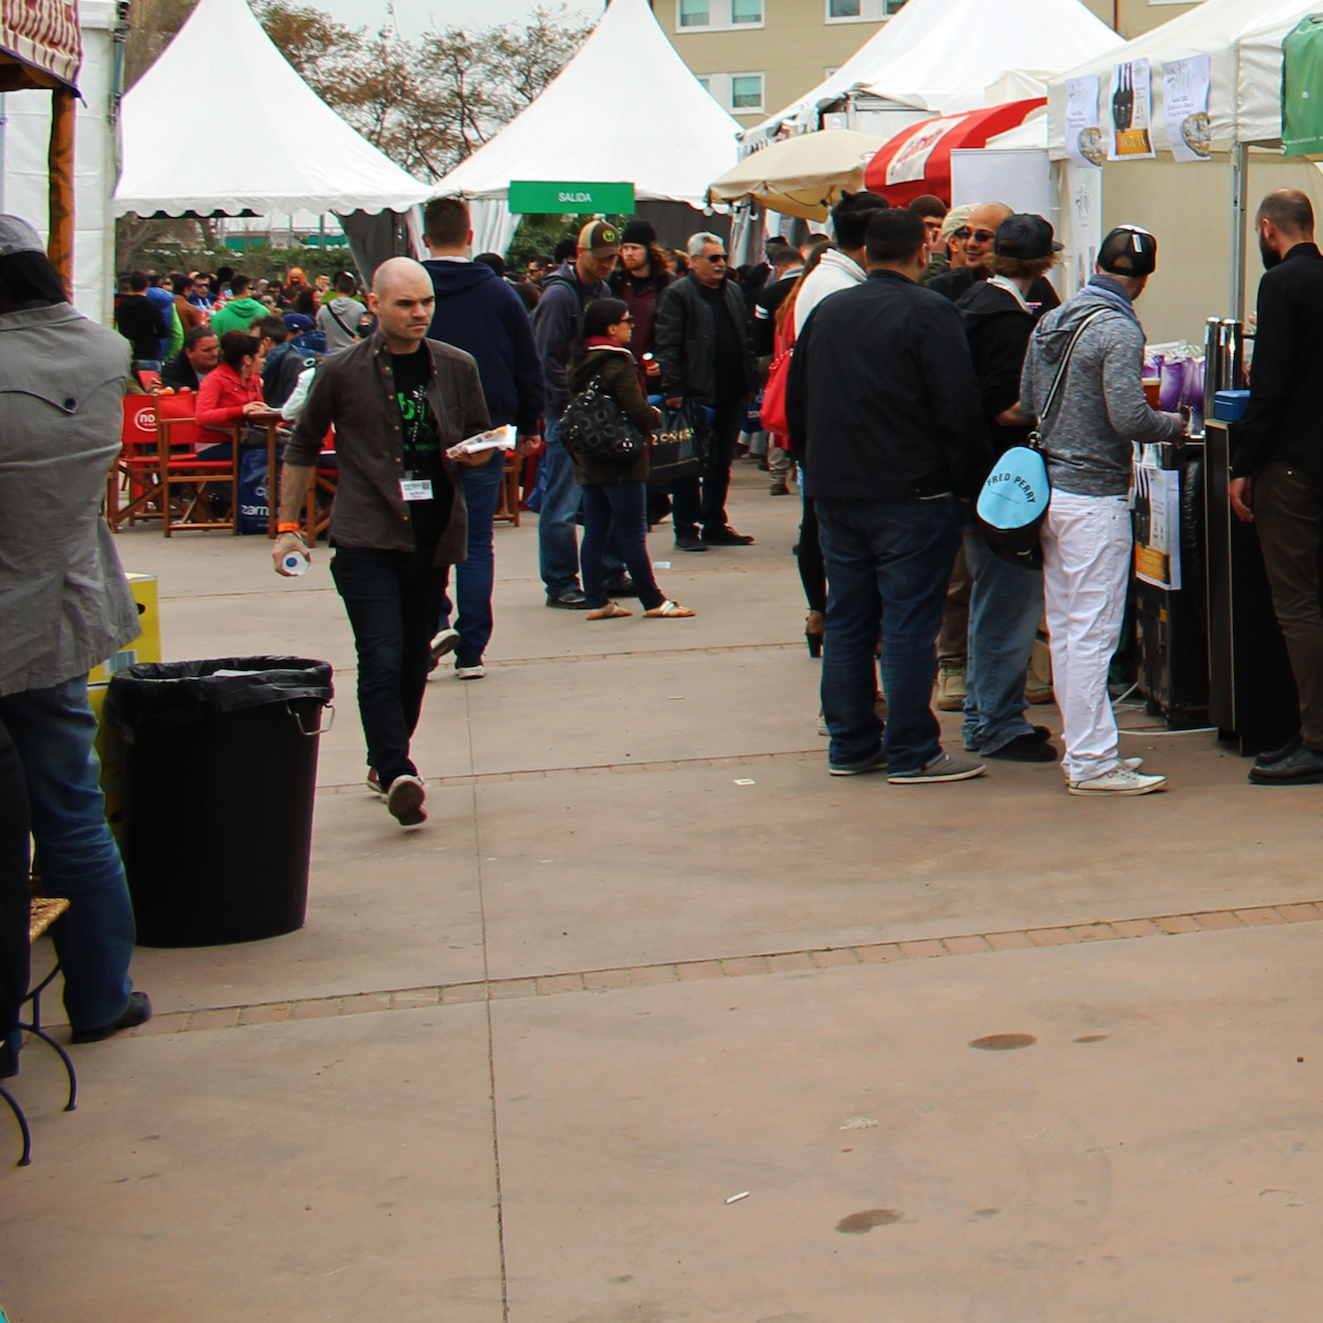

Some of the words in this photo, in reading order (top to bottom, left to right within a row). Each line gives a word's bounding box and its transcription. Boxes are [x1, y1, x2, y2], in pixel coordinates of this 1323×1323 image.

[558, 192, 592, 203] SALIDA
[987, 472, 1011, 487] FRED
[1013, 475, 1037, 504] PERRY
